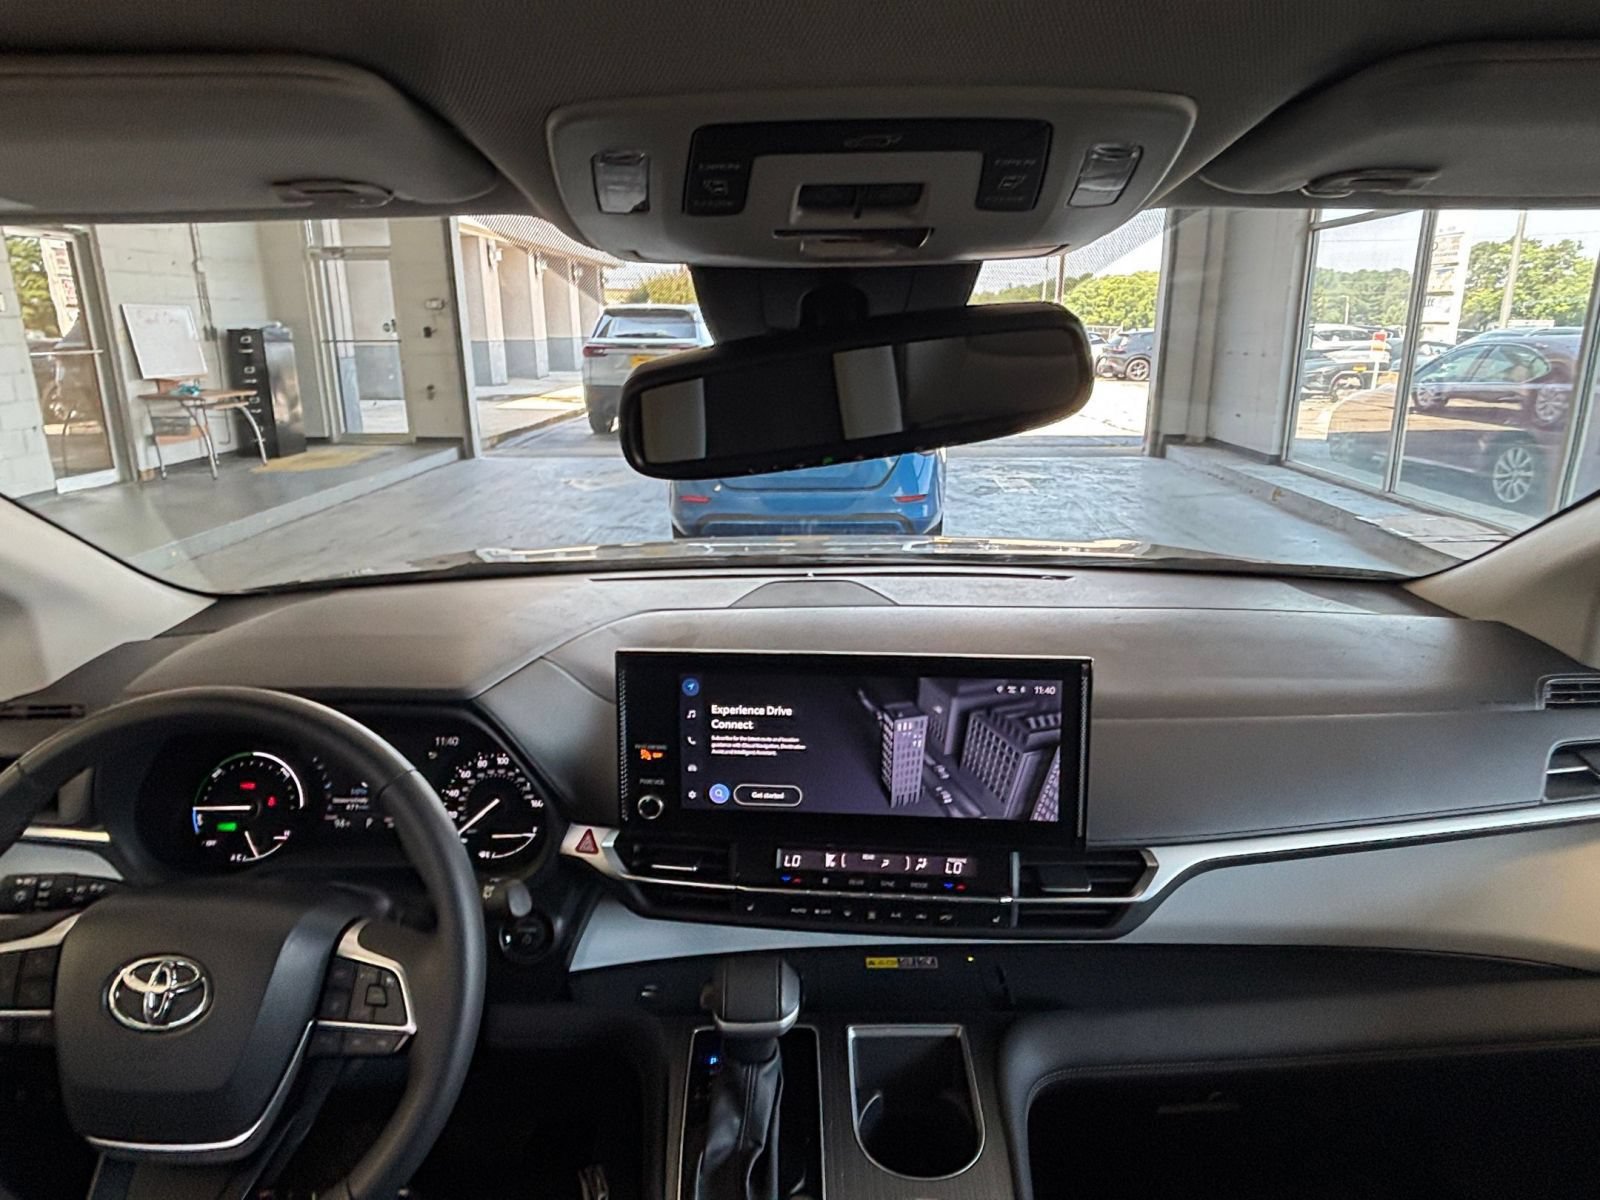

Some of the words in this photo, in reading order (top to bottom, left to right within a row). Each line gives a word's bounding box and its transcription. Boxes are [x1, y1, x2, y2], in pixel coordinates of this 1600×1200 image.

[1034, 686, 1057, 695] 11:40
[711, 704, 765, 717] Experience
[766, 705, 793, 716] Drive
[711, 719, 755, 730] Connect
[496, 757, 510, 765] 100
[460, 770, 472, 779] 60
[448, 788, 460, 798] 40
[783, 854, 802, 868] LO
